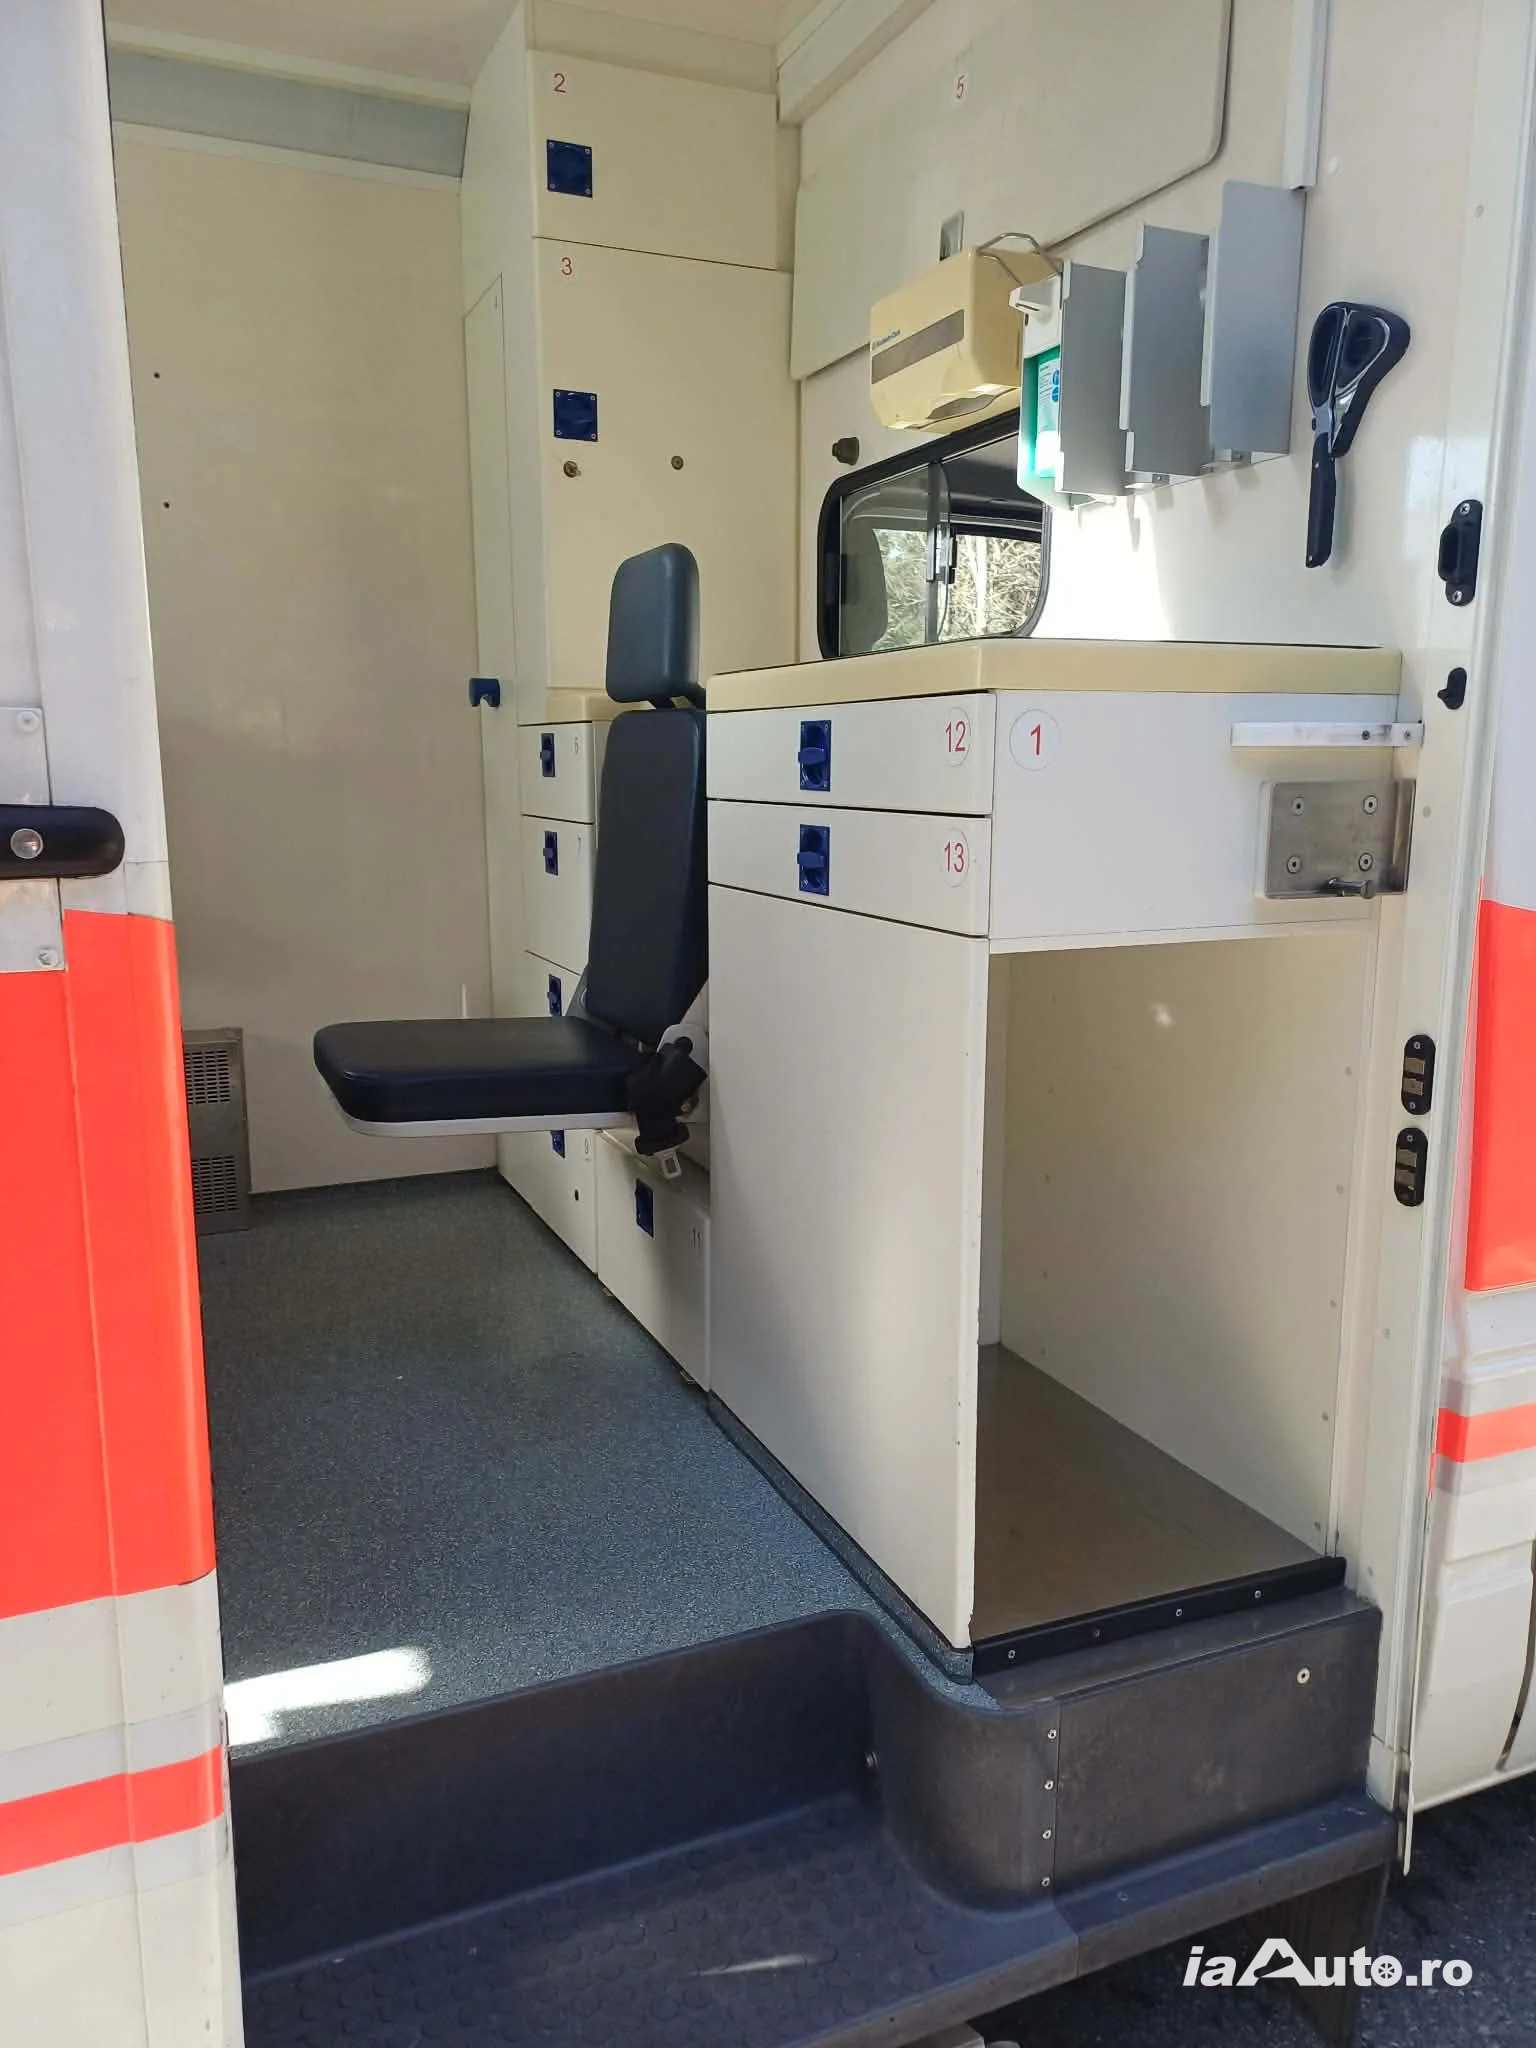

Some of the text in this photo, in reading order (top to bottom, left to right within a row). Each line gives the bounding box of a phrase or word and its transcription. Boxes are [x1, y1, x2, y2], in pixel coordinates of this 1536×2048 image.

[554, 72, 566, 93] 2
[957, 74, 965, 100] 5
[561, 256, 573, 276] 3
[945, 720, 967, 753] 12
[1030, 723, 1041, 755] 1
[944, 841, 965, 873] 13
